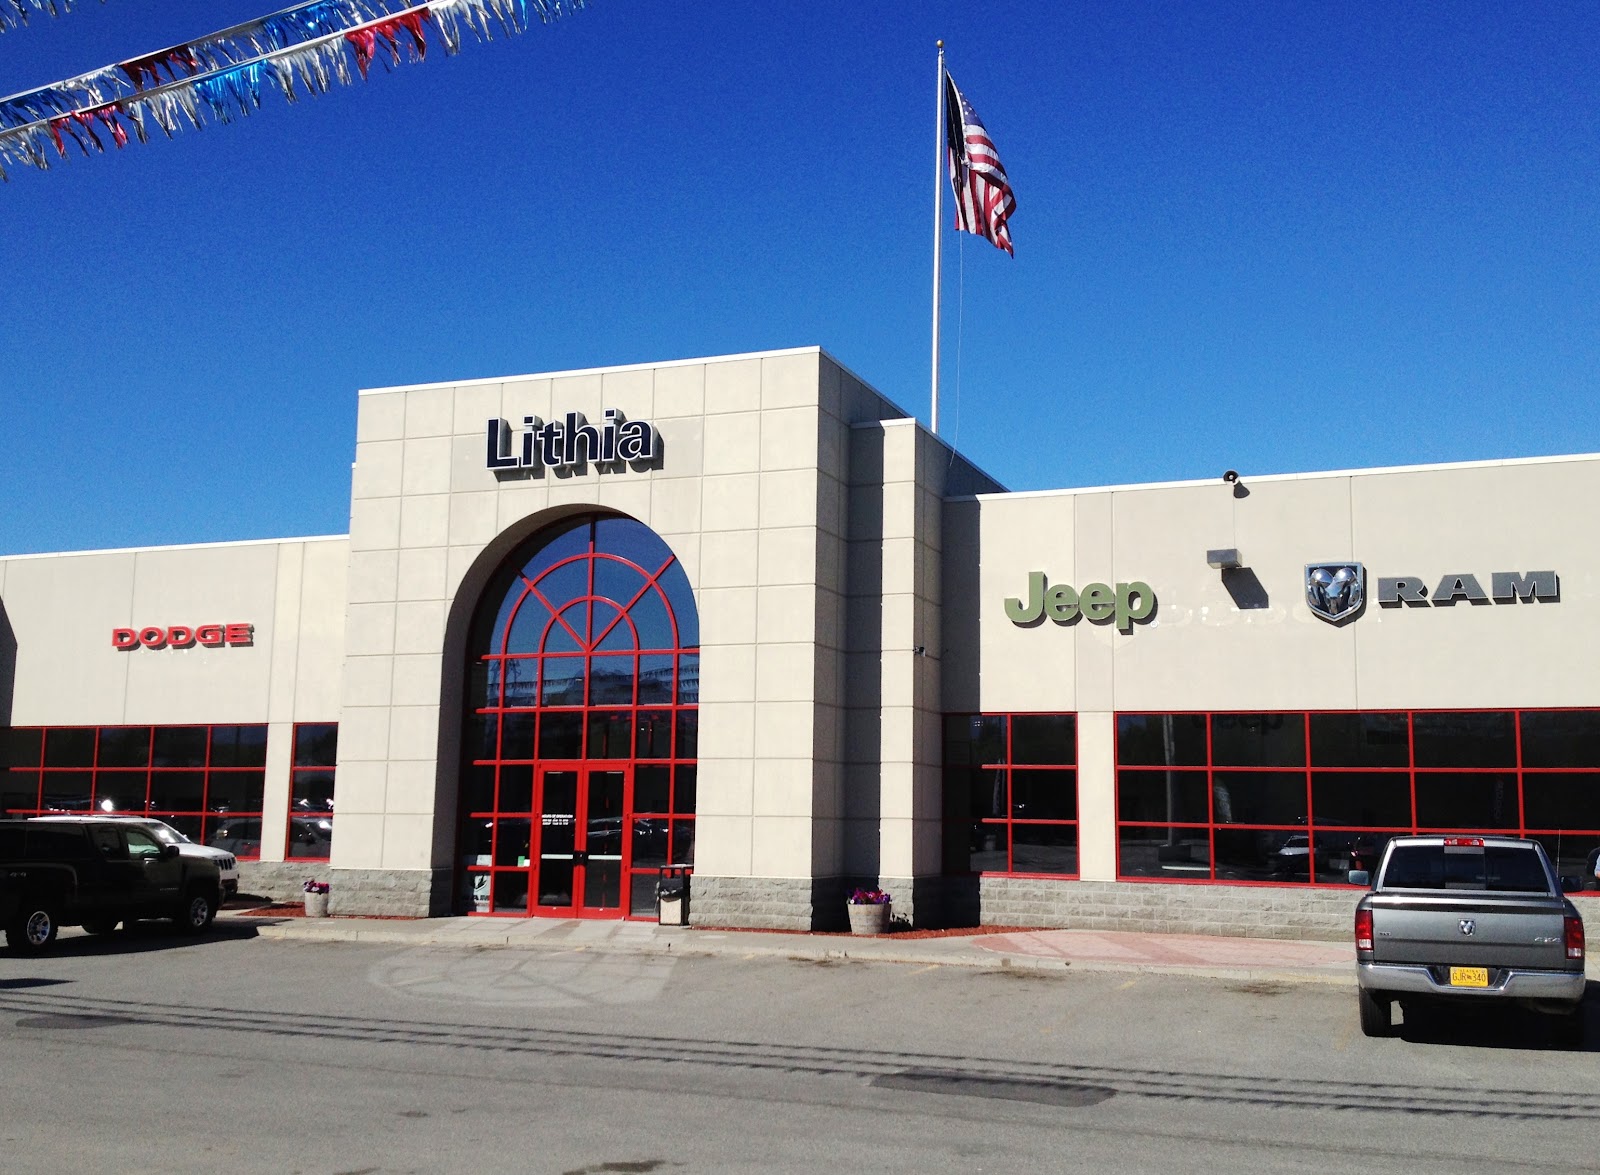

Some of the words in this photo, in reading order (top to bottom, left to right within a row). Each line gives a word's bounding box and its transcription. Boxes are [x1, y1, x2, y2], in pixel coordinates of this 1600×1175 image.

[486, 408, 658, 471] Lithia
[1004, 571, 1156, 631] Jeep
[1377, 570, 1559, 604] RAM
[112, 623, 252, 648] DODGE
